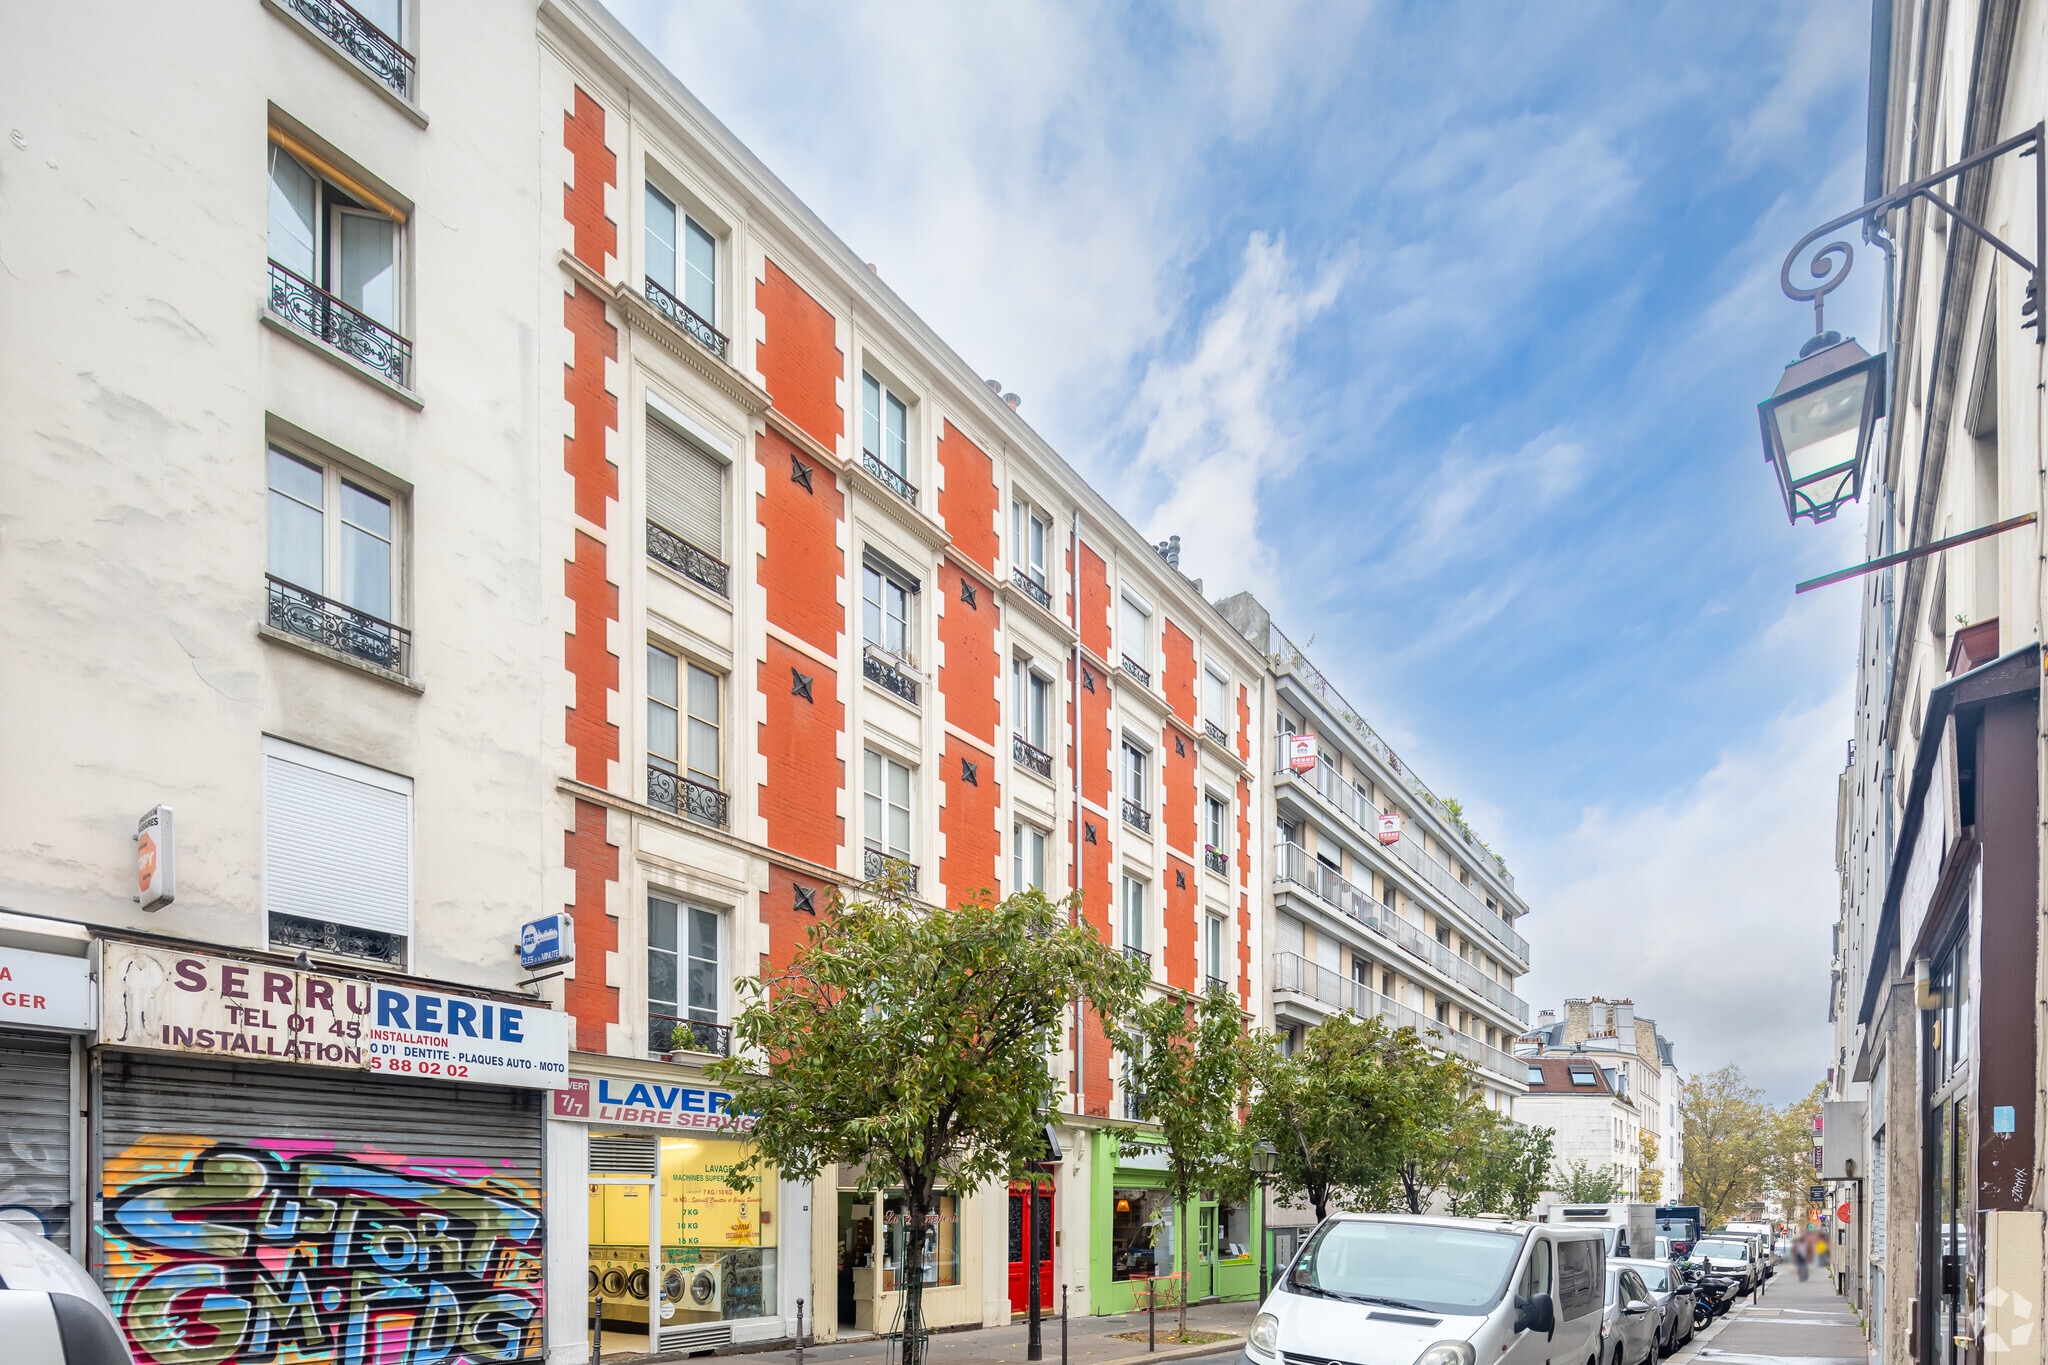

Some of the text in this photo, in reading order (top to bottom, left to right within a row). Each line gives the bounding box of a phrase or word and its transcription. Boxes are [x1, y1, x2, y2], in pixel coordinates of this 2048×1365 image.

[541, 949, 559, 960] MINUTE
[225, 1004, 362, 1039] TEL 01 45
[162, 1024, 361, 1064] INSTALLATION
[370, 1029, 449, 1048] INSTALLATION
[371, 1056, 468, 1077] 5 88 02 02
[404, 1046, 449, 1061] DENTITE
[459, 1052, 504, 1067] PLAQUES
[506, 1058, 532, 1069] AUTO
[540, 1061, 565, 1073] MOTO
[561, 1095, 583, 1115] 7/7
[600, 1106, 756, 1131] LIBRE SERVIC
[673, 1174, 704, 1182] MACHINES
[688, 1208, 699, 1216] KG
[677, 1222, 699, 1230] 10 KG
[678, 1237, 699, 1245] 16 KG
